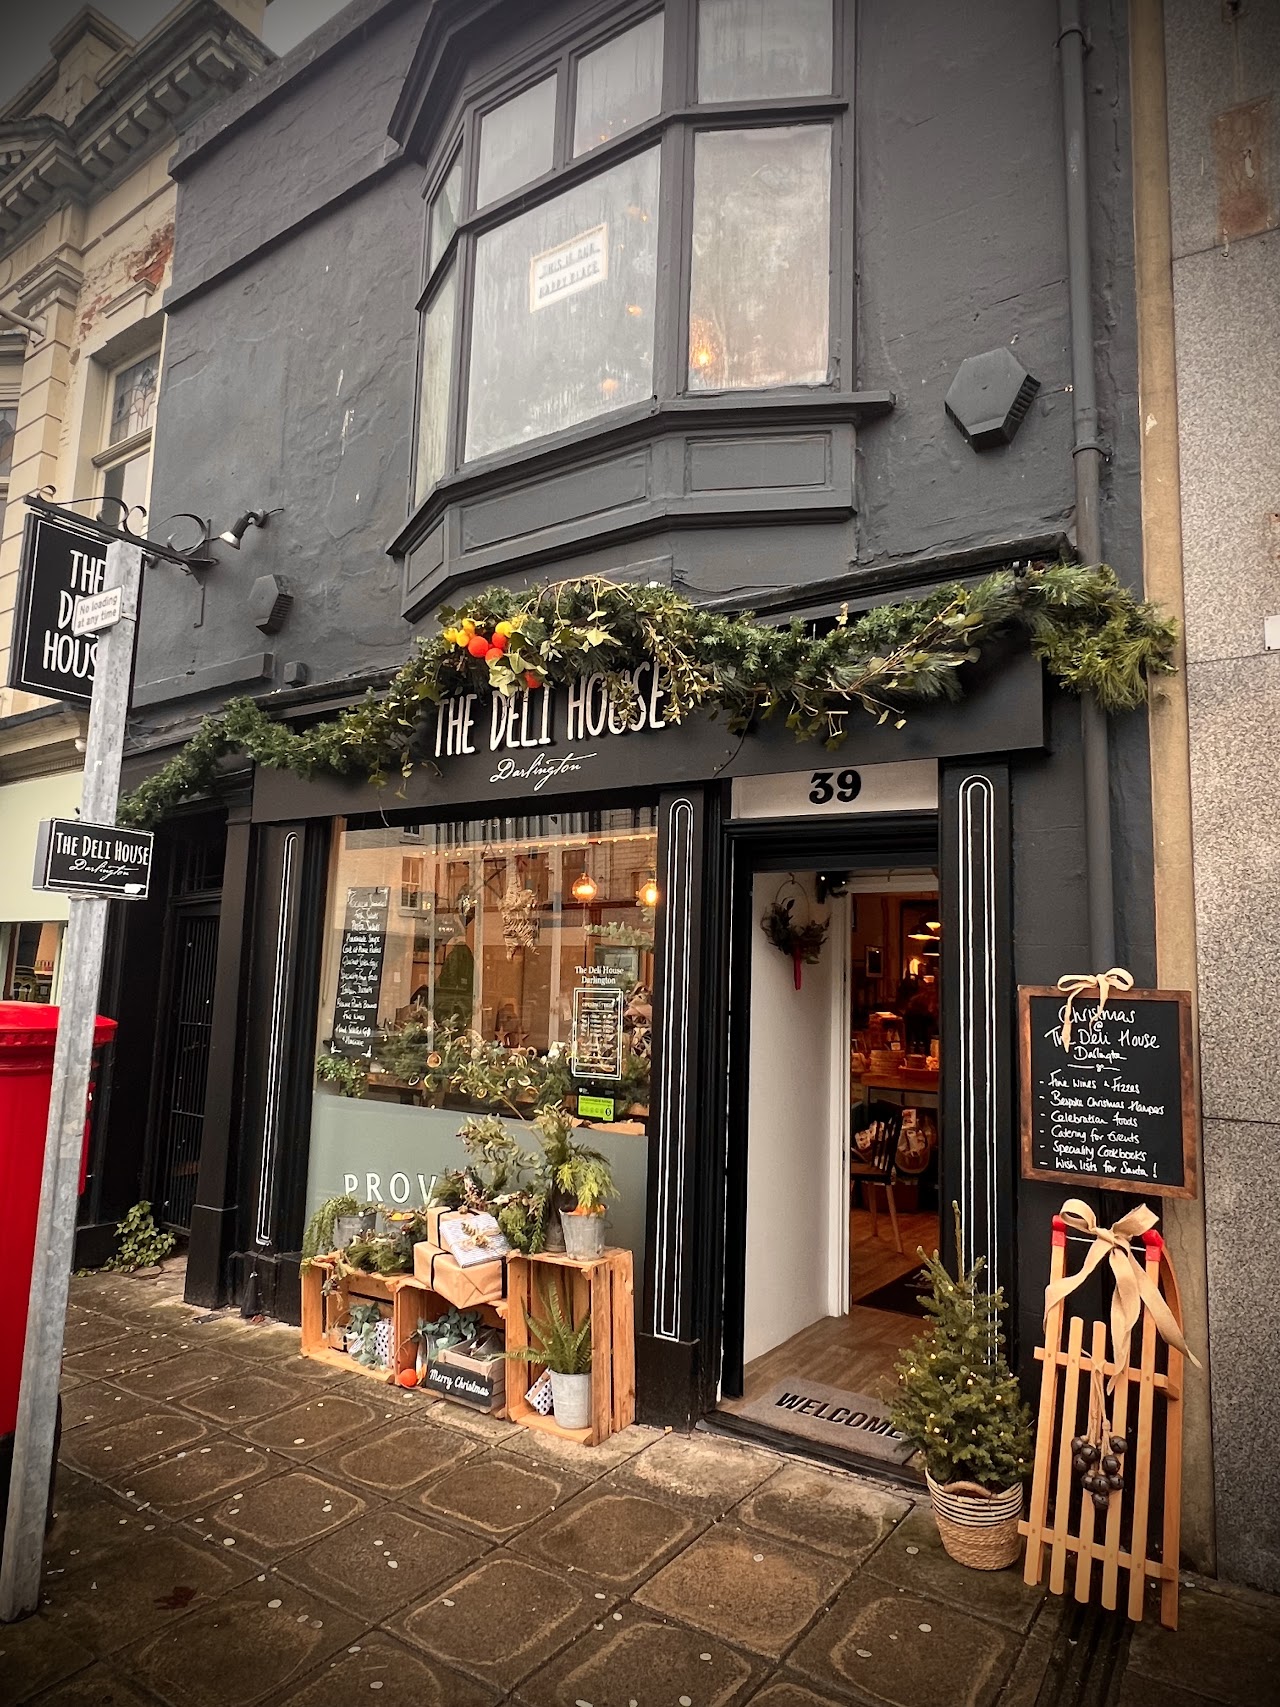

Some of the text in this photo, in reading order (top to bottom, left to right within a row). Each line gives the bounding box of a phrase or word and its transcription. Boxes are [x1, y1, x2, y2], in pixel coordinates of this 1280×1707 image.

[80, 595, 117, 615] No loading
[78, 609, 117, 628] at any time
[435, 661, 672, 758] THE DELI HOUSE
[489, 752, 598, 791] Darlington
[809, 769, 862, 805] 39
[56, 832, 149, 866] THE DELI HOUSE
[68, 858, 139, 881] Darlington
[574, 965, 624, 975] The Deli House
[581, 976, 616, 986] Darlington
[1058, 1005, 1136, 1024] Christmas
[1078, 1028, 1111, 1045] Deli
[1118, 1029, 1160, 1048] House
[1048, 1069, 1069, 1088] Fine
[1111, 1076, 1140, 1094] Fizzes
[1050, 1090, 1165, 1116] Bespoke Christmas Hampers
[1050, 1109, 1108, 1124] Celebration
[1051, 1124, 1140, 1144] Catering for Events
[1097, 1145, 1147, 1161] Cookbooks
[1055, 1157, 1078, 1170] Wish
[1079, 1159, 1097, 1172] lists
[1103, 1160, 1117, 1173] for
[429, 1368, 490, 1397] Merry Christmas
[775, 1392, 907, 1440] WELCOME
